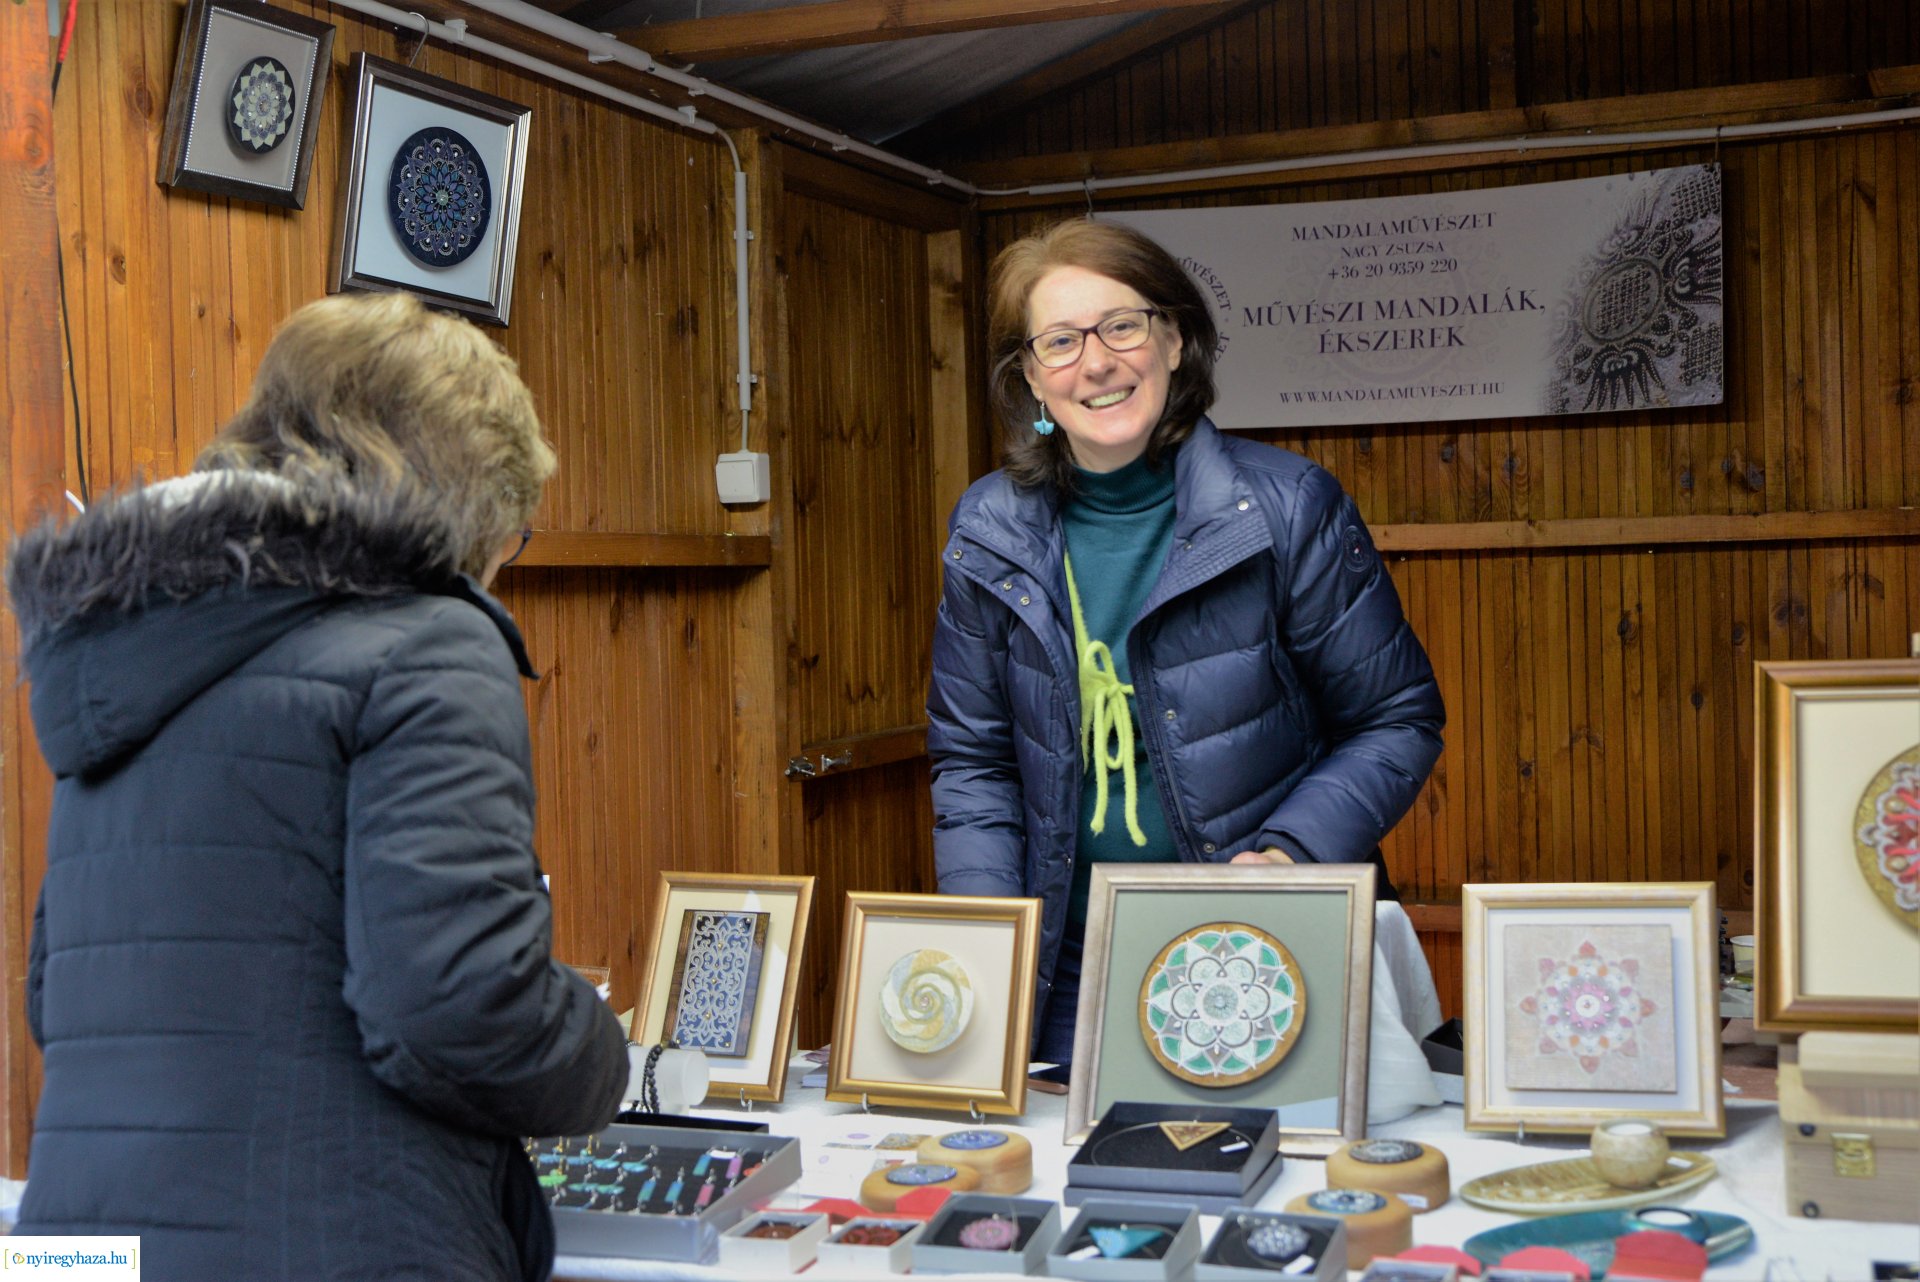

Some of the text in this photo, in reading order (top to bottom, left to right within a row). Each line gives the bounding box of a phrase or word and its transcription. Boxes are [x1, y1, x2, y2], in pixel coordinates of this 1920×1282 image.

[1291, 212, 1497, 241] MANDALAMŰVÉSZET
[1341, 241, 1445, 259] NAGY ZSUZSA
[1328, 258, 1458, 280] +36 20 9359 220
[1243, 286, 1546, 327] MŰVÉSZI MANDALÁK,
[1319, 326, 1465, 354] ÉKSZEREK
[1279, 382, 1505, 403] WWW.MANDALAMUVESZET.HU
